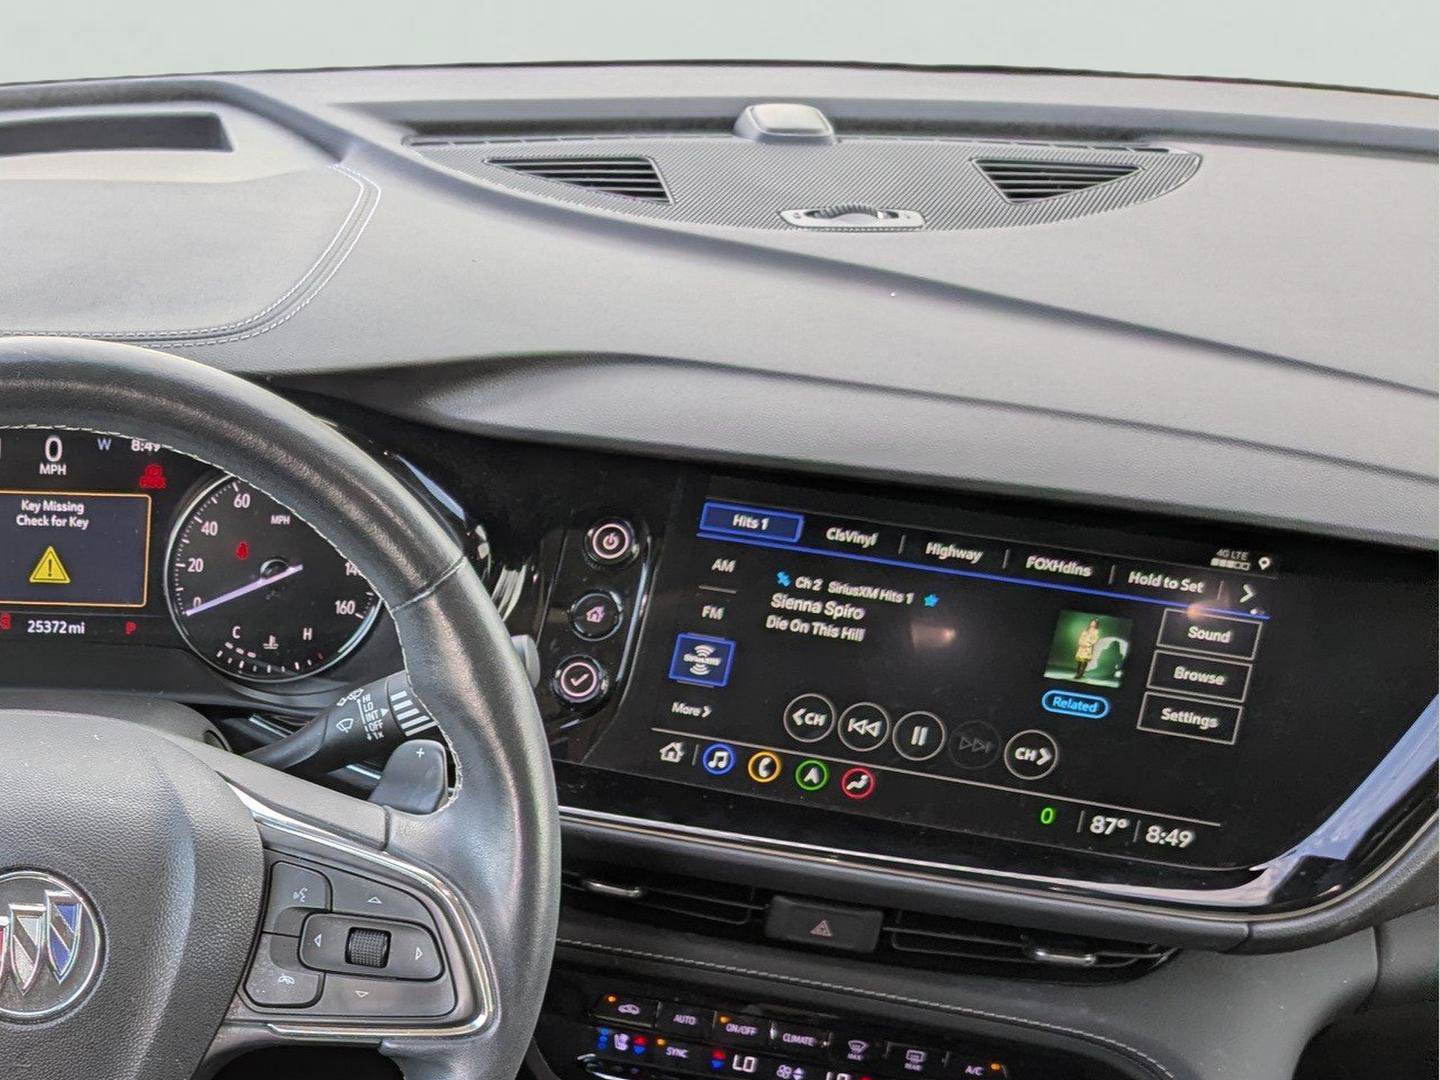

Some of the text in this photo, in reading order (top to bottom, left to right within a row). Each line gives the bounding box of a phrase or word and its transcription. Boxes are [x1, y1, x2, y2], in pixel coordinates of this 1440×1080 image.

[45, 435, 63, 462] 0
[97, 438, 111, 451] W
[39, 463, 67, 476] MPH
[21, 500, 85, 515] Key Missing
[234, 494, 250, 508] 60
[16, 515, 89, 530] Check for Key
[270, 514, 290, 526] MPH
[732, 513, 769, 531] Hits 1
[201, 521, 219, 536] 40
[825, 527, 879, 549] ClsVinyl
[925, 541, 984, 564] Highway
[1216, 548, 1249, 561] 4G LTE
[187, 558, 204, 573] 20
[712, 558, 736, 574] AM
[1026, 554, 1094, 578] FOXHdlns
[1128, 571, 1206, 594] Hold to Set
[795, 576, 915, 606] Ch 2 SiriusXM Hits 1
[335, 600, 356, 615] 160
[701, 605, 725, 621] FM
[770, 593, 866, 621] Sienna Spiro
[125, 621, 137, 635] P
[232, 626, 241, 639] C
[303, 628, 313, 640] H
[766, 614, 866, 642] Die On This Hill
[1188, 626, 1232, 644] Sound
[1173, 666, 1226, 686] Browse
[363, 702, 374, 713] LO
[671, 702, 702, 717] More
[1052, 696, 1099, 714] Related
[804, 712, 826, 728] CH
[1161, 707, 1220, 730] Settings
[369, 721, 384, 733] OFF
[1015, 747, 1037, 762] CH
[1040, 807, 1056, 826] 0
[1089, 816, 1131, 836] 87°
[1145, 825, 1195, 849] 8:49
[673, 1014, 697, 1026] AUTO
[726, 1022, 758, 1036] ON/OFF
[782, 1032, 817, 1047] CLIMATE
[666, 1046, 689, 1059] SYNC
[732, 1055, 758, 1073] LO
[965, 1065, 985, 1077] A/C
